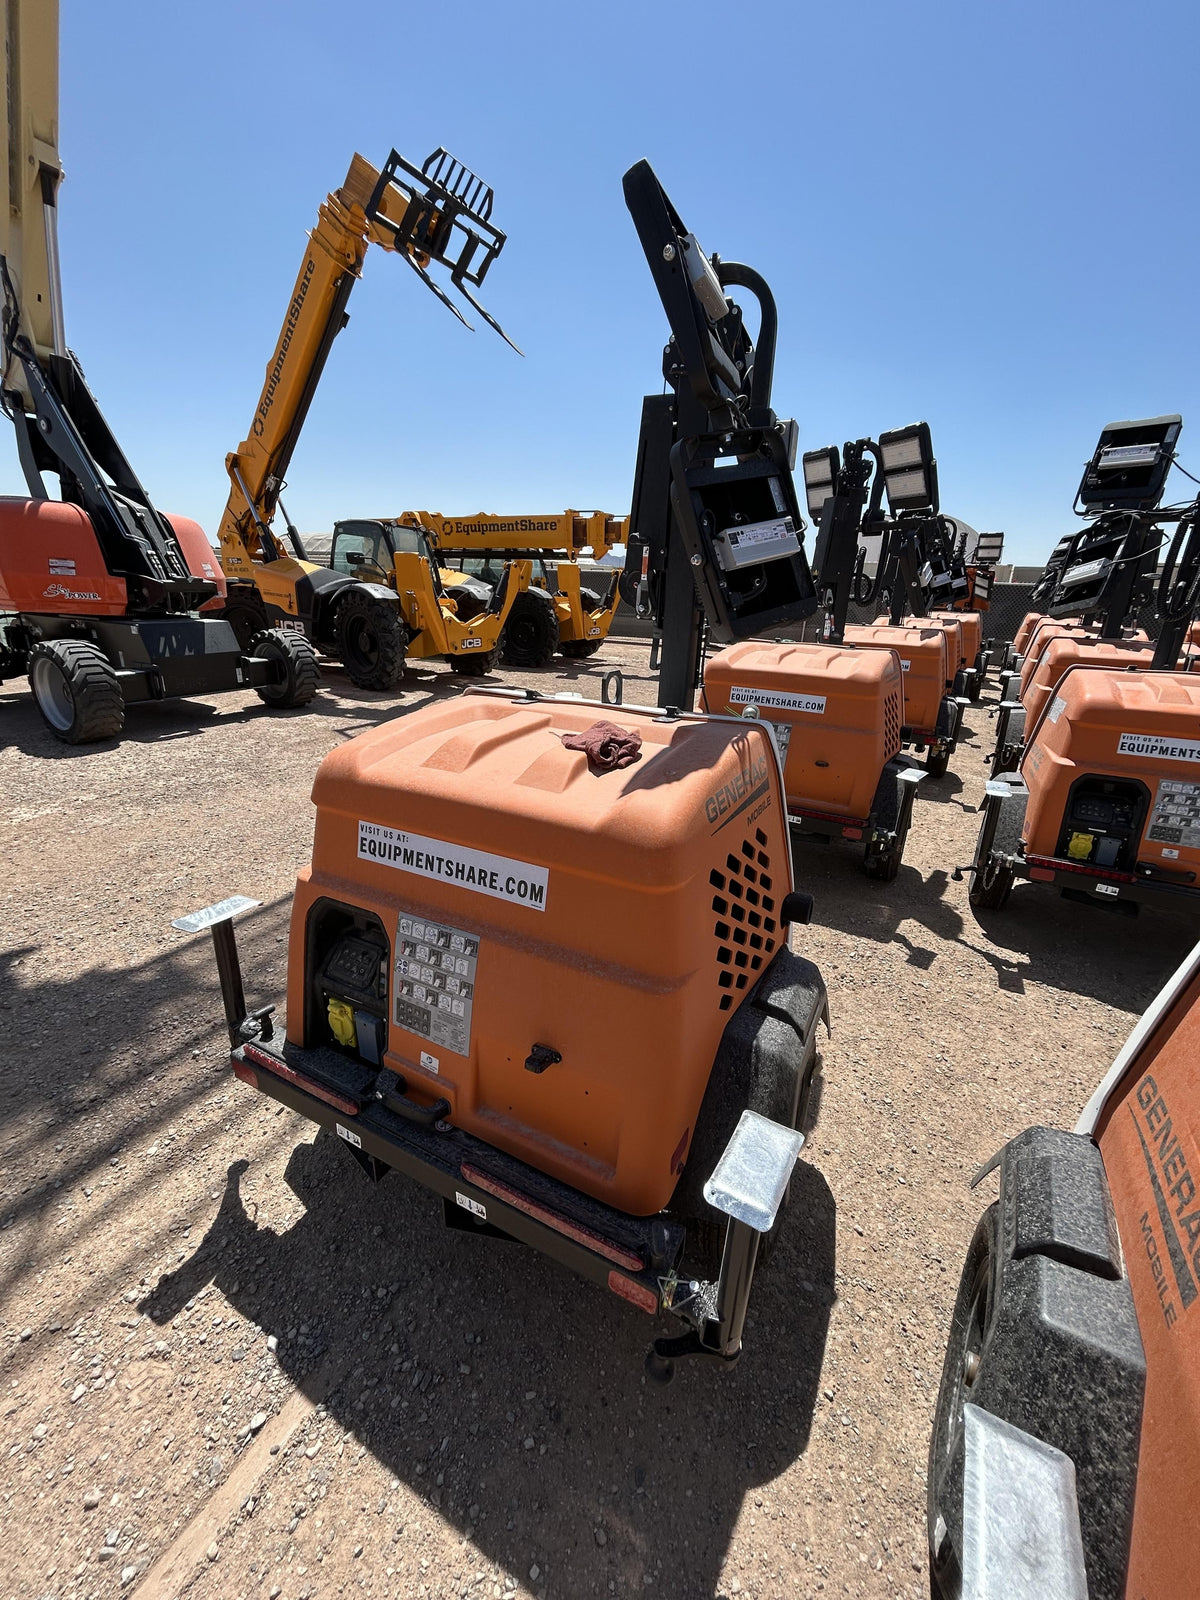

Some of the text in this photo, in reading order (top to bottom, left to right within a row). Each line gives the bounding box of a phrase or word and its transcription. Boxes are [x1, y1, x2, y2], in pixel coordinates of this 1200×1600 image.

[259, 259, 316, 420] EquipmentShare
[455, 519, 558, 536] EquipmentShare
[461, 638, 482, 649] JCB
[588, 627, 600, 636] JCB
[731, 693, 824, 711] EQUIPMENTSHARE.COM
[704, 755, 767, 824] GENERAC
[747, 795, 772, 827] MOBILE
[360, 823, 409, 843] VISIT US AT:
[359, 836, 545, 904] EQUIPMENTSHARE.COM
[1139, 1210, 1178, 1330] MOBILE
